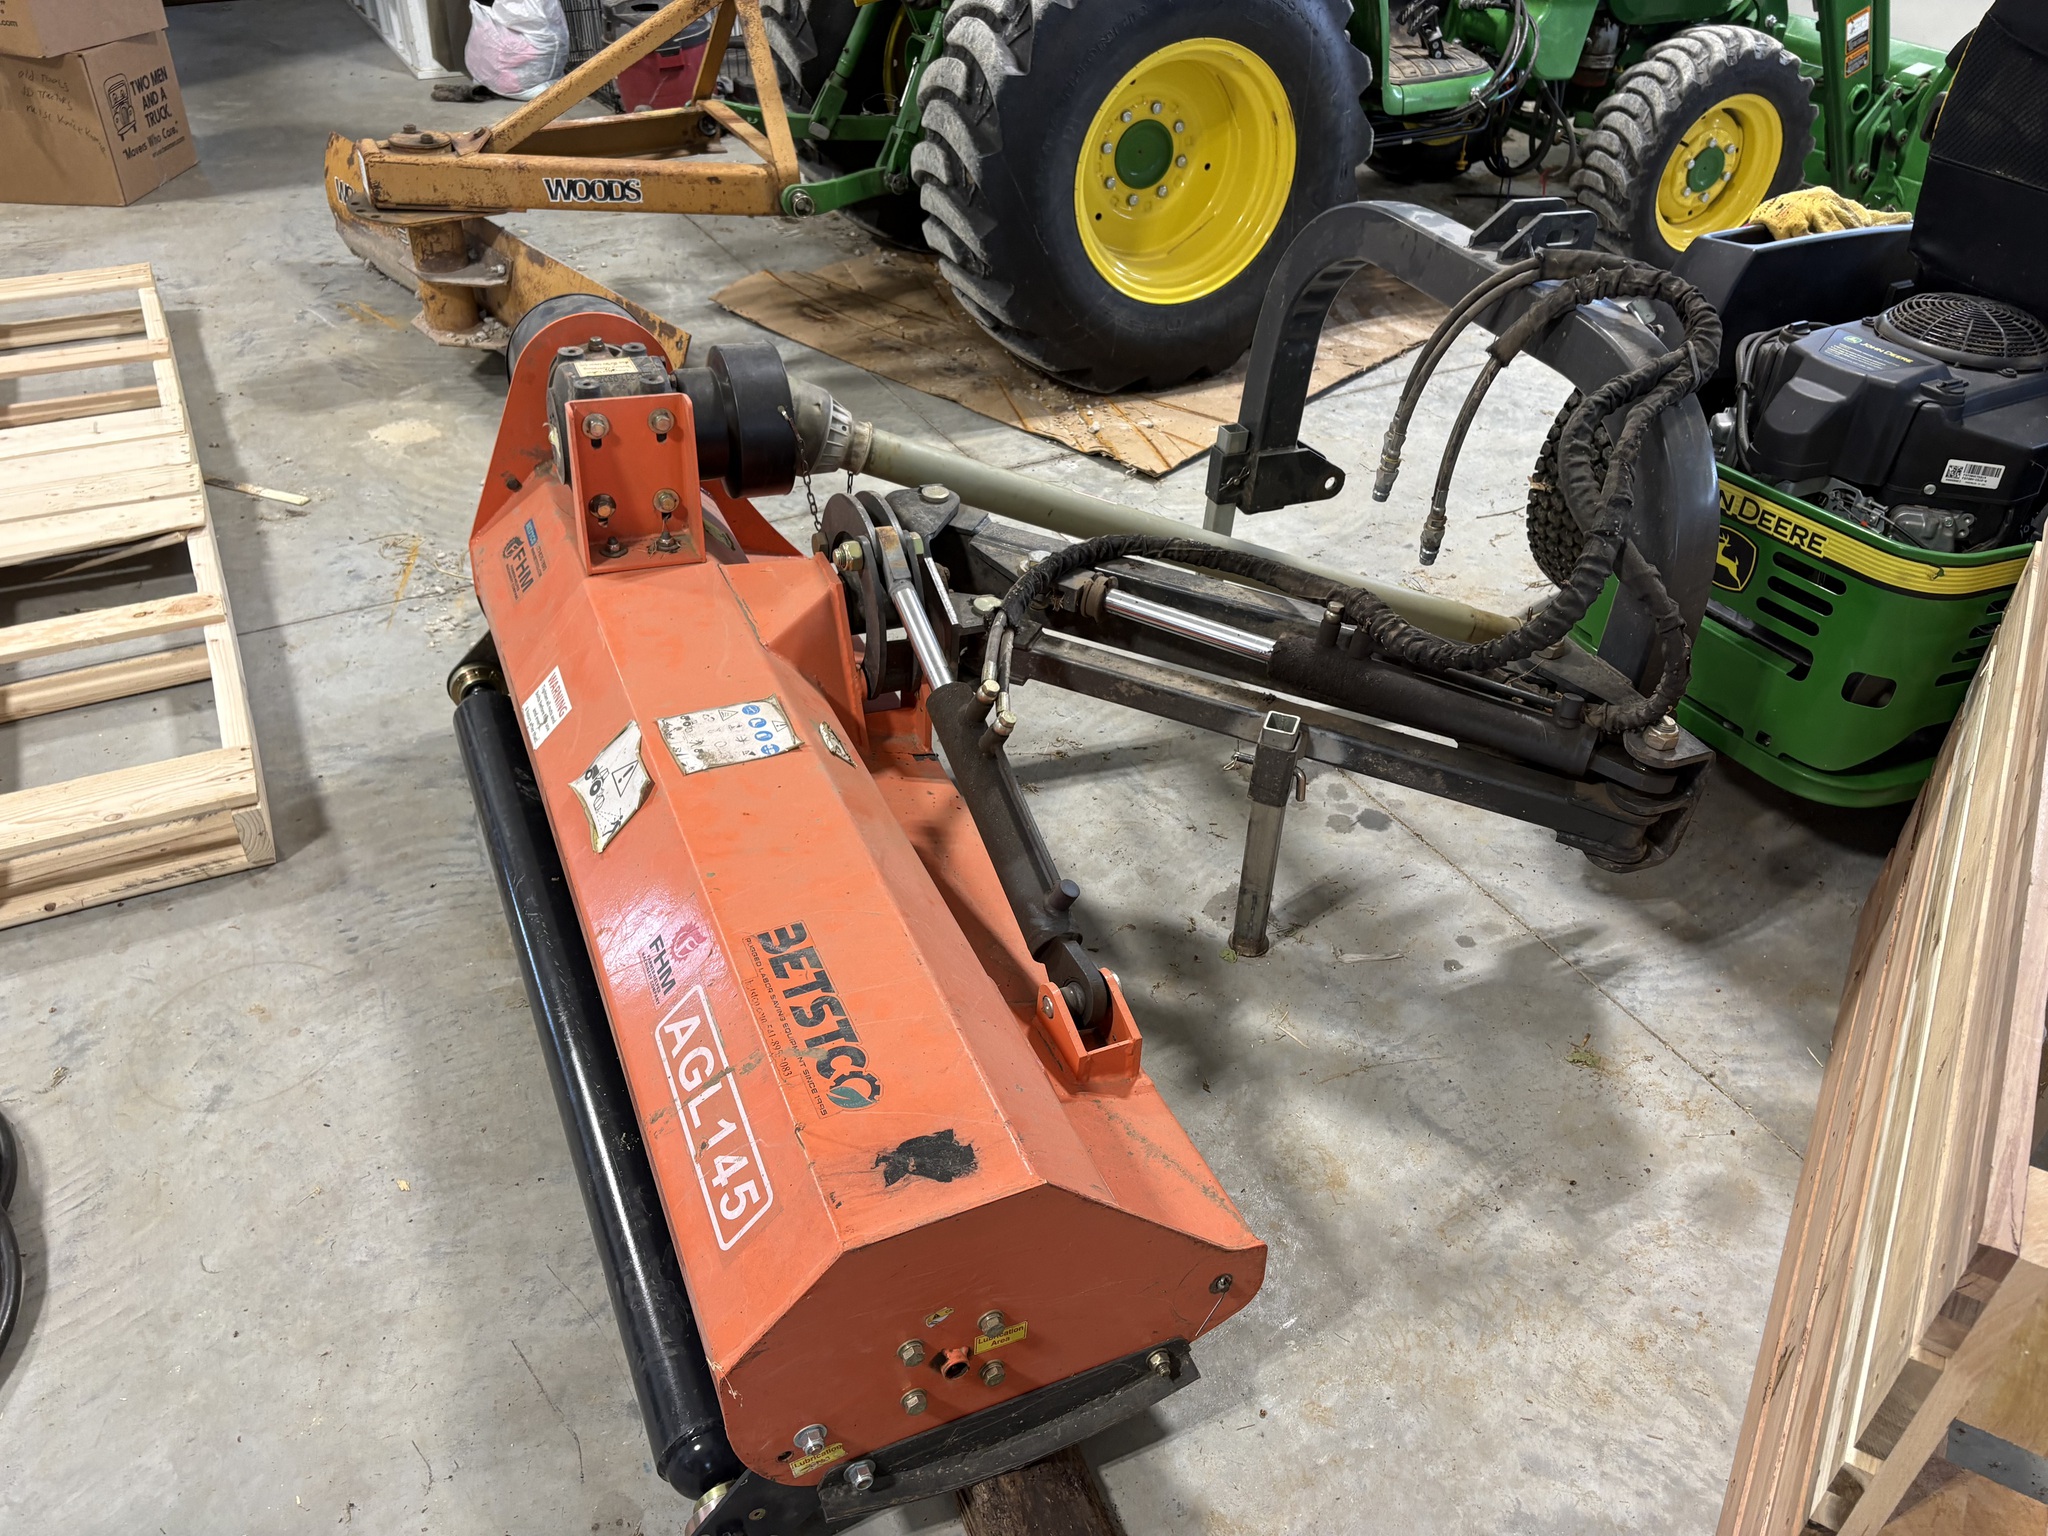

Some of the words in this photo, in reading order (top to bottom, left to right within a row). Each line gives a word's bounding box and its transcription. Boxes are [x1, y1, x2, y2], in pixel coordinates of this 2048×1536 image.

[130, 75, 150, 96] TWO
[150, 66, 168, 86] MEN
[142, 91, 159, 111] AND
[160, 87, 168, 101] A
[147, 133, 161, 147] Who
[543, 178, 643, 203] WOODS
[1738, 496, 1827, 554] DEERE
[513, 547, 534, 593] FHM
[548, 672, 568, 718] WARNING
[649, 934, 676, 995] FHM
[745, 937, 762, 967] RUGGED
[758, 966, 774, 993] LABOR
[770, 994, 786, 1022] SAVING
[783, 1022, 806, 1068] EQUIPMNT
[803, 1069, 818, 1094] SINCE
[814, 1095, 828, 1116] 1995
[991, 1336, 1011, 1347] Area
[794, 1445, 842, 1468] Lubrication
